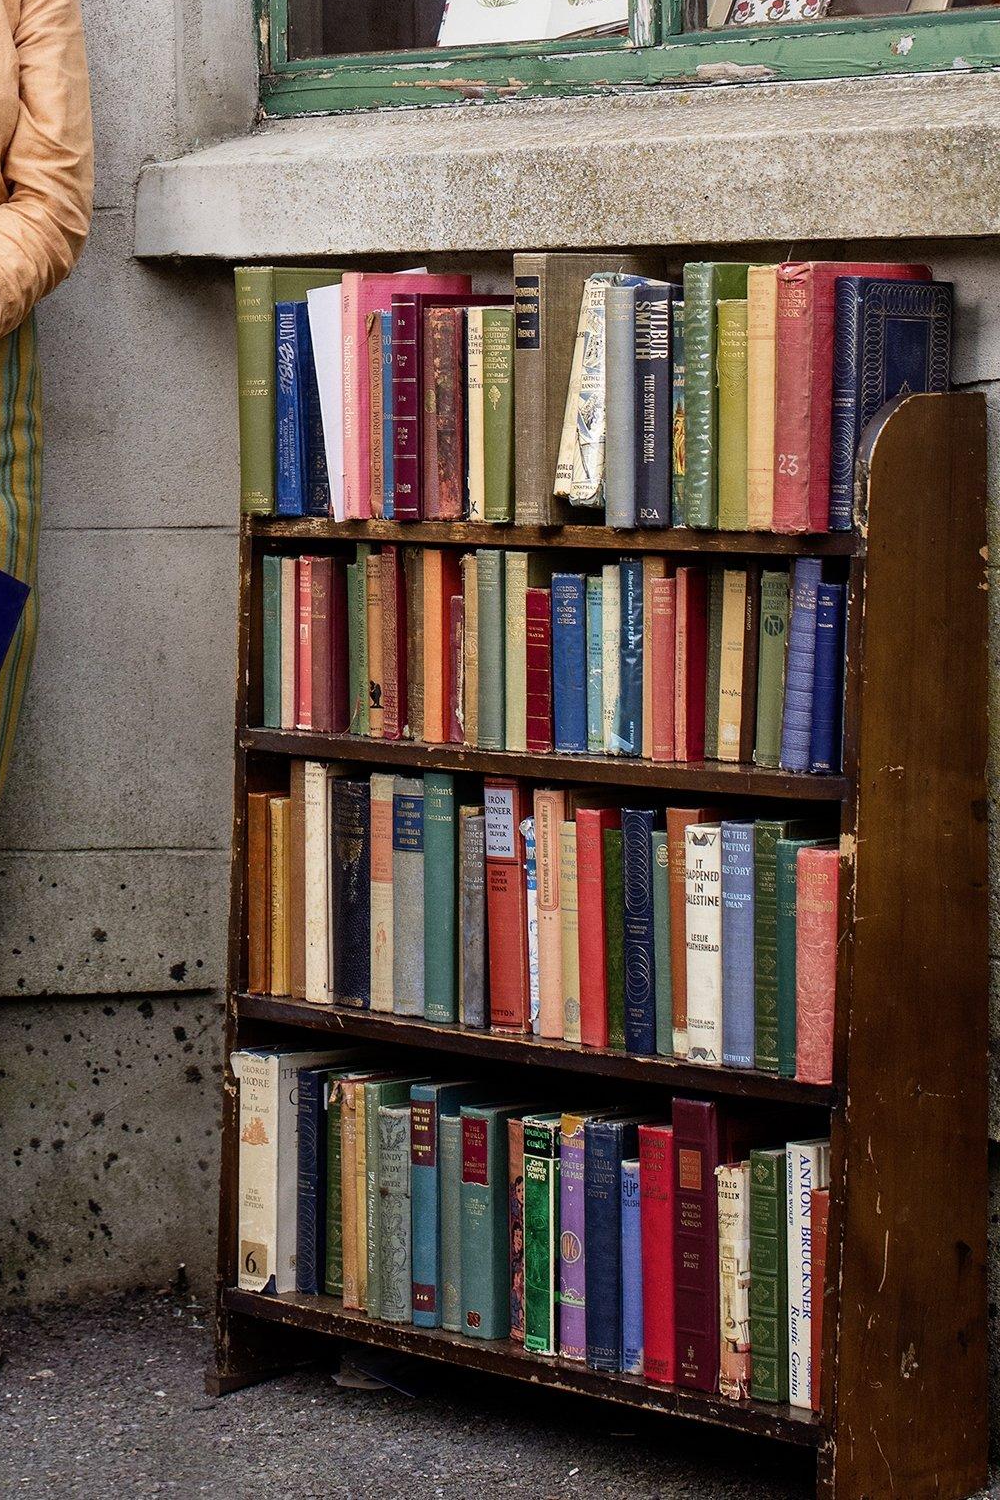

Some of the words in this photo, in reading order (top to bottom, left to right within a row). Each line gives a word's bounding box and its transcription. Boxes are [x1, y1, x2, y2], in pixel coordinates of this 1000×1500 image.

[280, 313, 295, 342] HOLY
[635, 300, 651, 360] SMITH
[650, 299, 669, 360] WILBUR
[279, 343, 295, 396] BIBLE
[343, 335, 353, 403] Shakespeare's
[644, 374, 655, 391] THE
[644, 392, 655, 432] SEVENTH
[344, 406, 354, 438] clown
[372, 411, 380, 435] FROM
[644, 433, 655, 463] SCROLL
[372, 439, 381, 496] DEDUCTIONS
[778, 454, 799, 477] 23
[640, 508, 659, 519] BCA
[628, 615, 634, 625] LA
[488, 796, 506, 804] IRON
[732, 831, 748, 840] THE
[696, 859, 704, 868] IT
[728, 855, 739, 863] OF
[695, 883, 704, 892] IN
[727, 893, 751, 901] CHARLES
[691, 934, 708, 942] LESLIE
[242, 1065, 270, 1075] GEORGE
[281, 1068, 299, 1080] TH
[242, 1076, 270, 1088] MOORE
[526, 1140, 547, 1150] castle
[787, 1151, 793, 1160] by
[526, 1165, 547, 1175] COWPER
[529, 1160, 544, 1168] JOHN
[527, 1172, 546, 1182] POWYS
[799, 1153, 812, 1218] ANTON
[683, 1252, 700, 1260] GIANT
[683, 1261, 700, 1269] PRINT
[801, 1226, 812, 1320] BRUCKNER
[790, 1305, 800, 1346] Rustic
[790, 1352, 801, 1397] Genius
